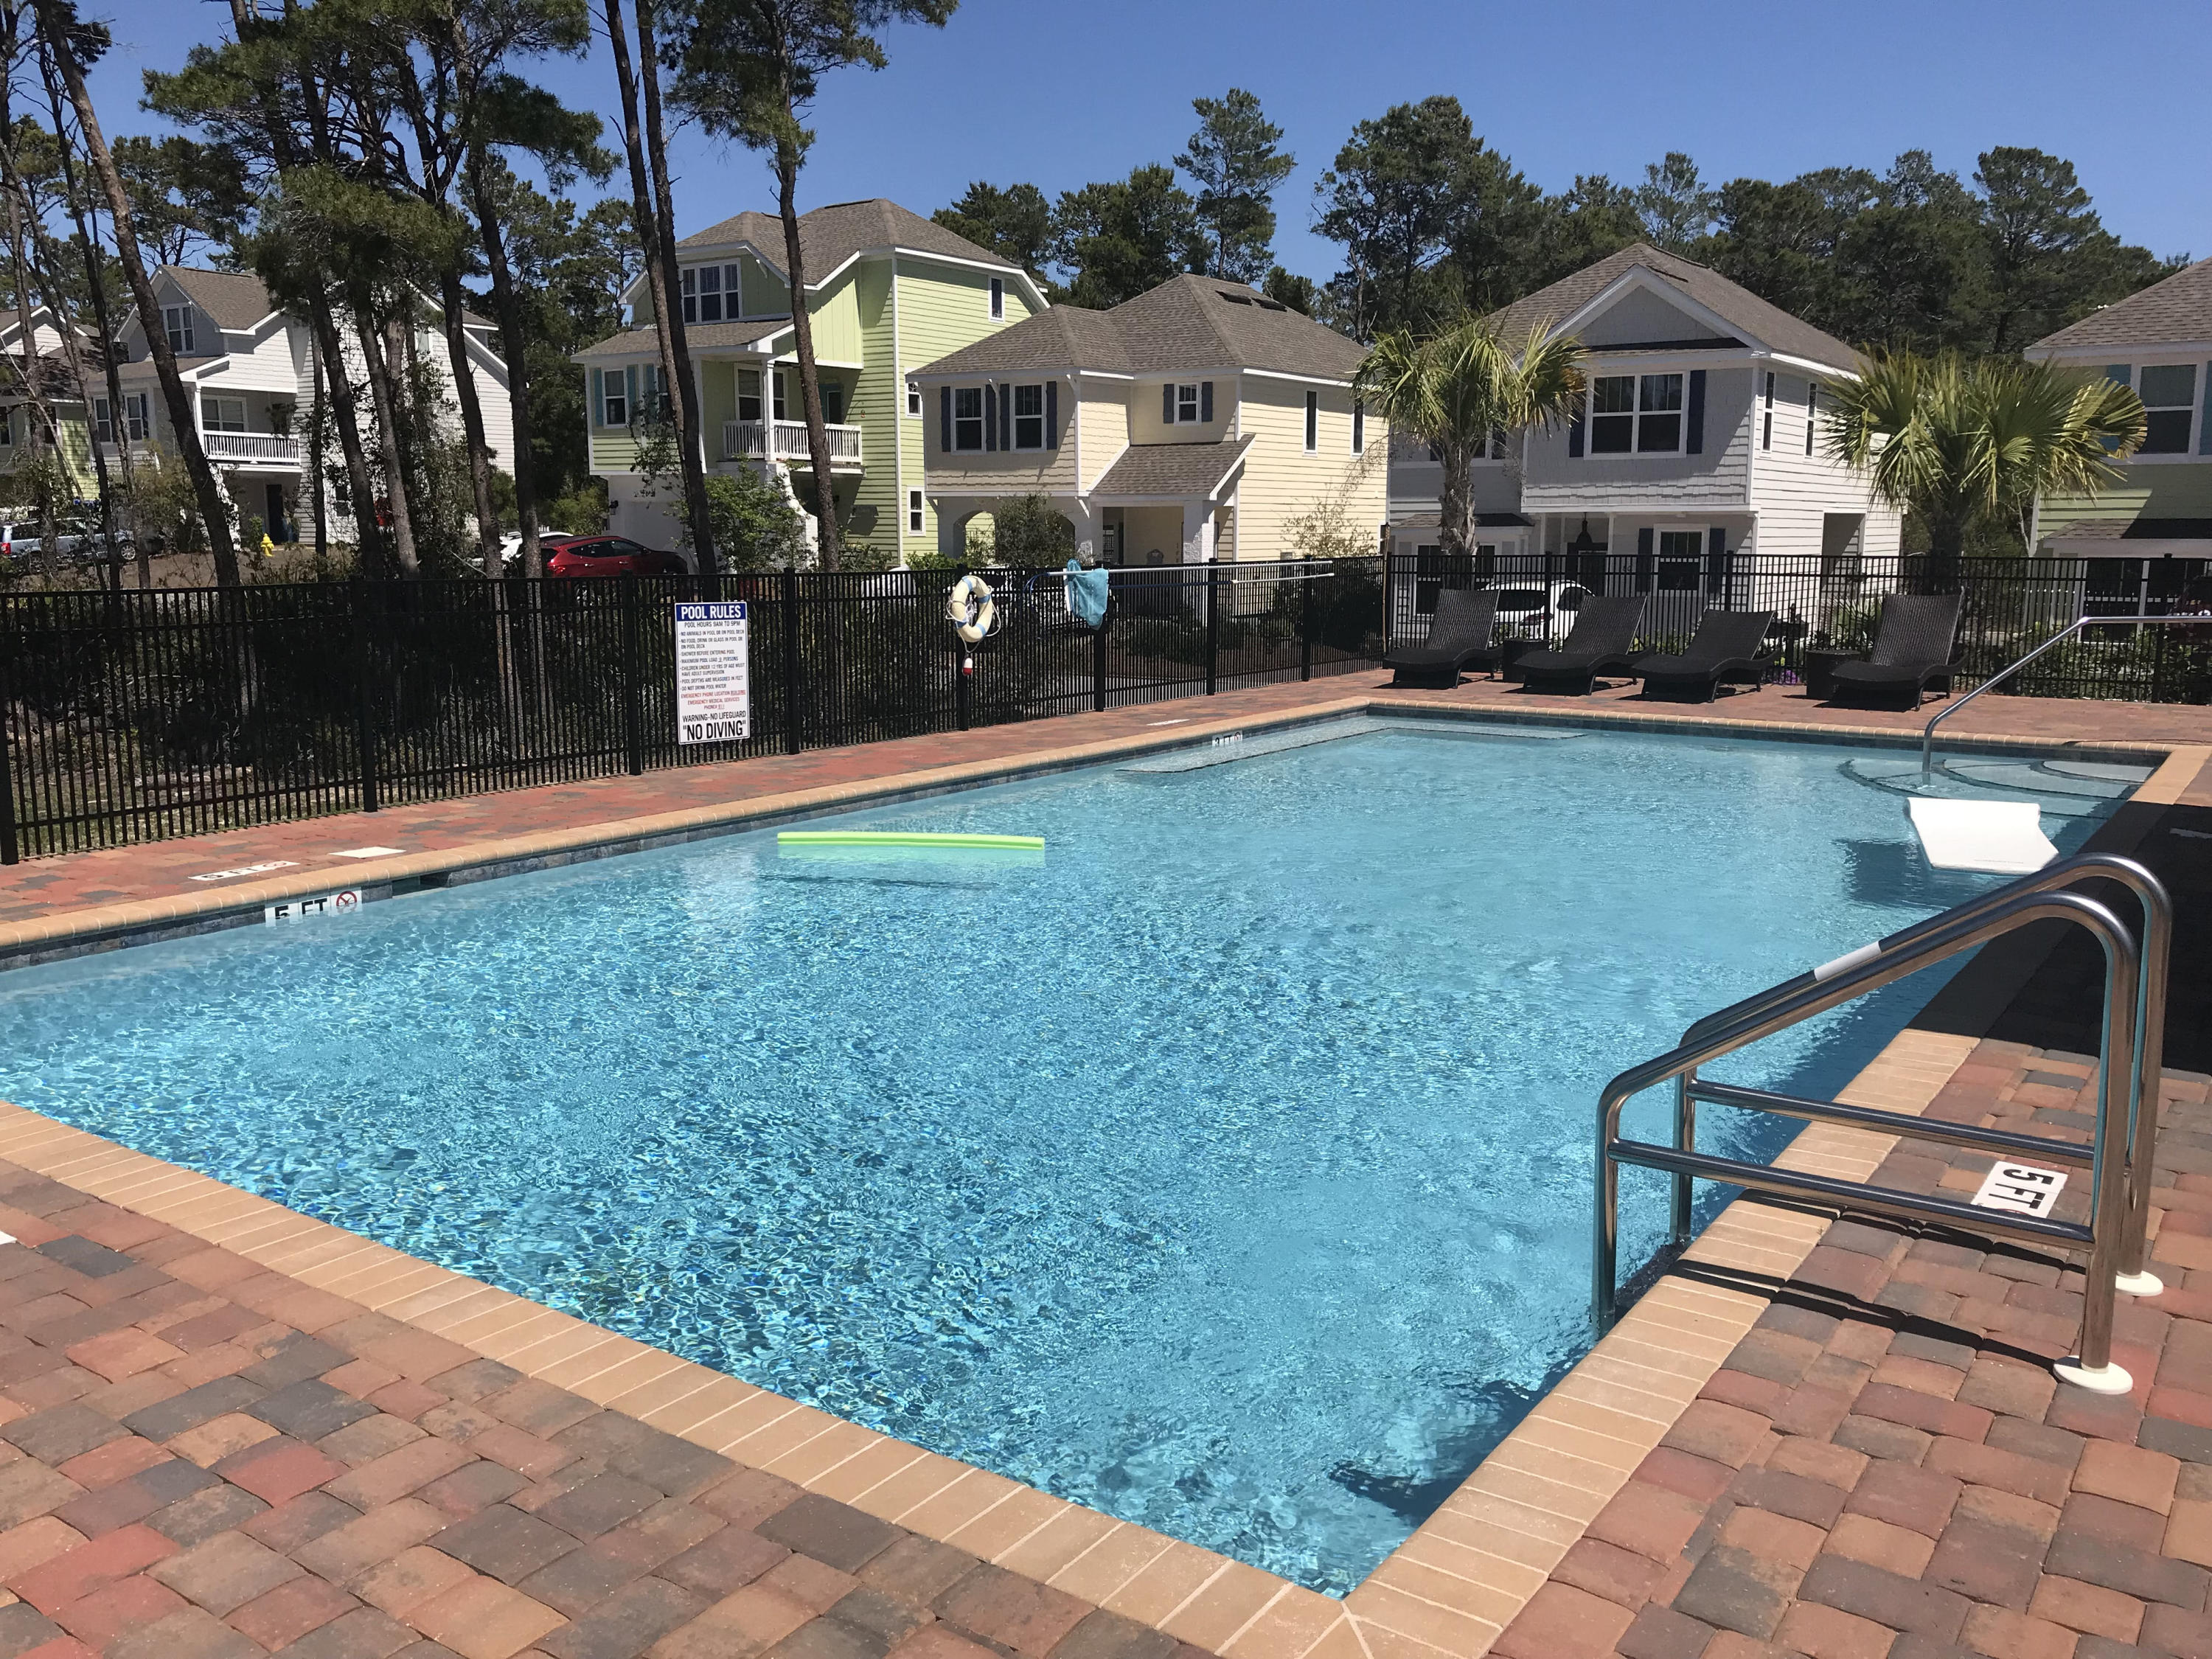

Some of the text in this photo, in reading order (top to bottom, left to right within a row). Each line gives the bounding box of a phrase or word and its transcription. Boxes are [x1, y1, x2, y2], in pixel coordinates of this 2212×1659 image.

[681, 605, 741, 619] POOL RULES
[683, 711, 746, 723] WARNING-NO LIFEGUARD
[683, 719, 746, 741] "NO DIVING"
[275, 898, 327, 919] 5 FT
[1988, 1168, 2055, 1209] 5 FT
